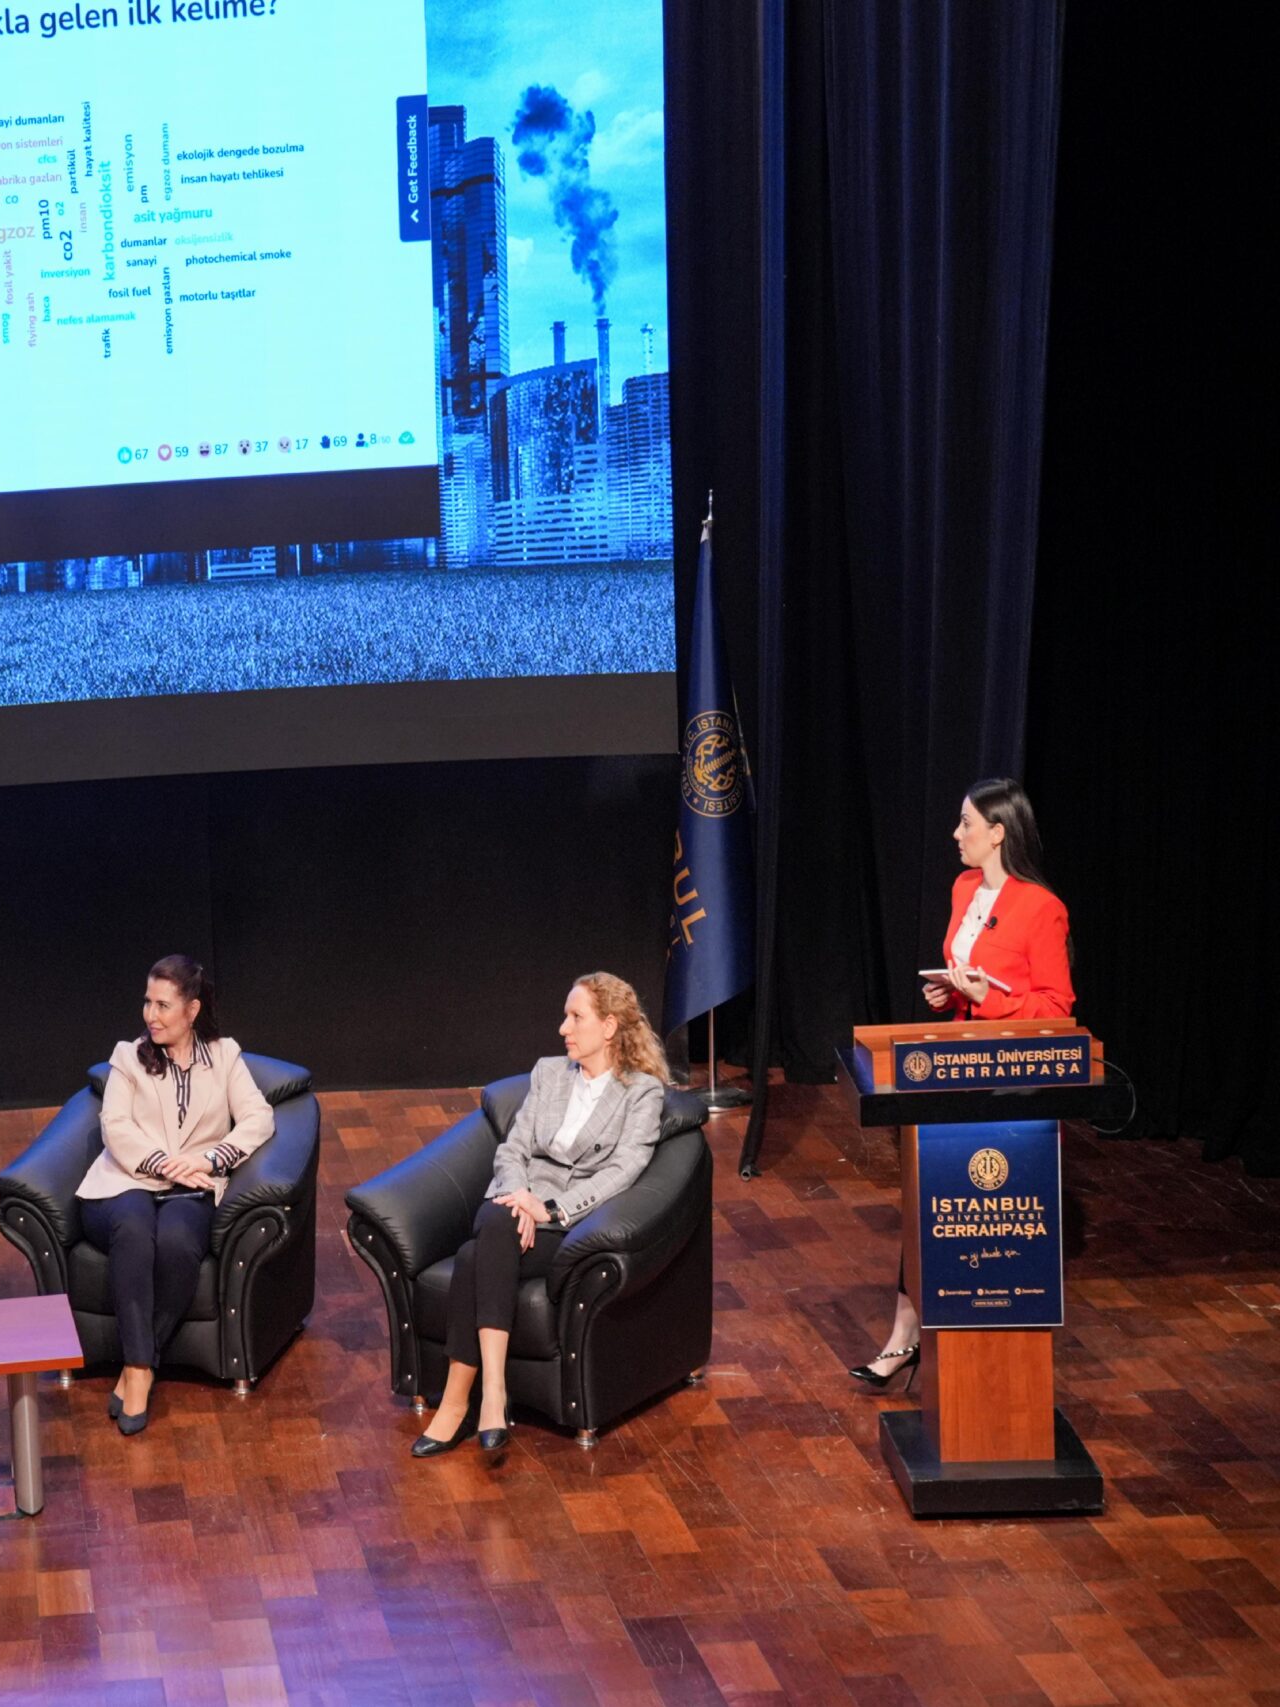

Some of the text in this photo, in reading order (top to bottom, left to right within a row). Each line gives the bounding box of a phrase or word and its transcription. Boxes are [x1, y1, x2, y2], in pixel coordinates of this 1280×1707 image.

[39, 4, 119, 38] gelen
[128, 0, 162, 25] ilk
[15, 114, 64, 126] dumanları
[15, 136, 64, 149] sistemleri
[82, 101, 94, 177] hayat kalitesi
[177, 143, 304, 162] ekolojik dengede bozulma
[406, 115, 419, 204] Get Feedback
[123, 134, 135, 192] emisyon
[161, 123, 173, 201] egzoz dumanı
[30, 173, 62, 185] gazları
[67, 149, 79, 194] partikül
[181, 168, 284, 184] insan hayatı tehlikesi
[5, 195, 19, 204] co
[140, 185, 149, 203] pm
[55, 201, 64, 216] o2
[133, 208, 213, 224] asit yağmuru
[39, 199, 53, 240] pm10
[97, 160, 115, 280] karbondioksit
[60, 230, 73, 261] co2
[120, 236, 167, 248] dumanlar
[126, 256, 157, 267] sanayi
[185, 249, 292, 267] photochemical smoke
[40, 267, 91, 278] inversiyon
[4, 280, 14, 305] fosil
[108, 286, 151, 299] fosil fuel
[179, 288, 256, 302] motorlu taşıtlar
[42, 296, 51, 322] baca
[162, 266, 174, 355] emisyon gazları
[26, 292, 37, 348] flying ash
[57, 311, 136, 326] nefes alamamak
[2, 313, 10, 344] smog
[102, 328, 111, 358] trafik
[214, 443, 228, 456] 87
[255, 441, 268, 453] 37
[295, 439, 308, 450] 17
[333, 436, 347, 447] 69
[135, 448, 149, 461] 67
[175, 446, 189, 458] 59
[933, 1046, 1082, 1066] İSTANBUL ÜNİVERSİTESİ
[937, 1063, 1080, 1079] CERRAHPAŞA
[932, 1196, 1044, 1213] İSTANBUL
[937, 1213, 1041, 1222] ÜNİVERSİTESİ
[932, 1222, 1047, 1239] CERRAHPAŞA
